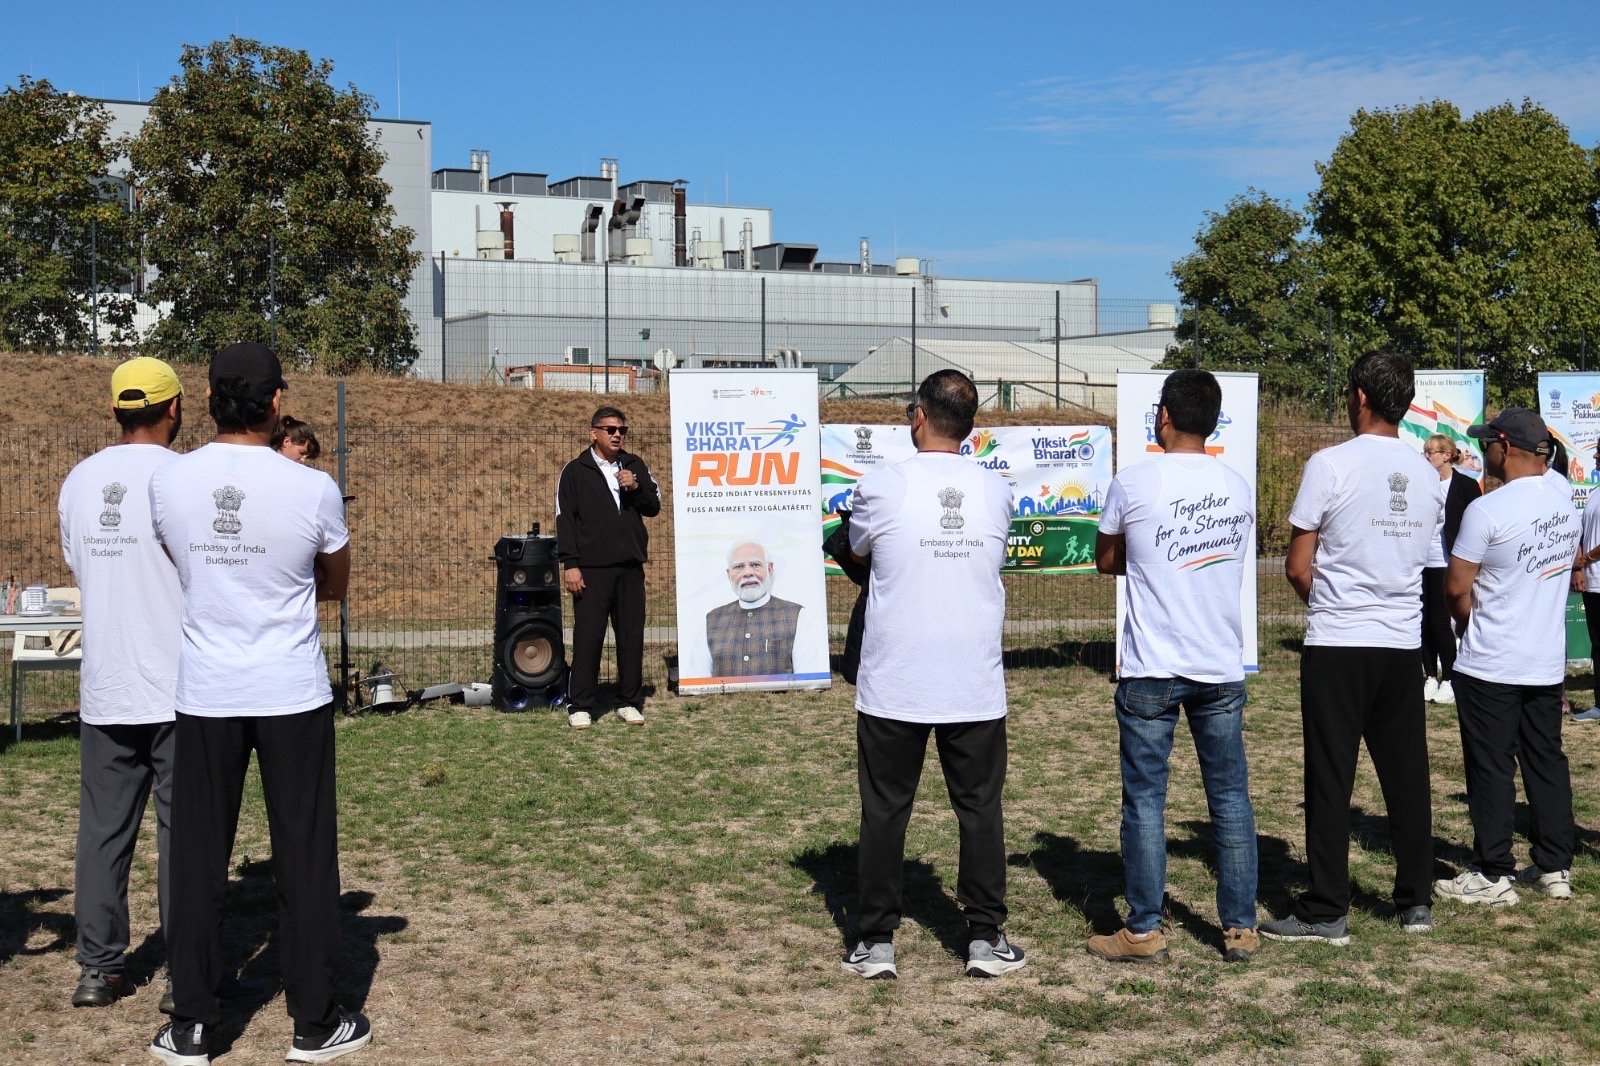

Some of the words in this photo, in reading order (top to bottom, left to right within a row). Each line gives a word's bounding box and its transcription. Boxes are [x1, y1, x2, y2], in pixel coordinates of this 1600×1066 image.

[1572, 400, 1592, 411] Sewa
[1573, 409, 1600, 420] Pakhwa
[685, 421, 745, 437] VIKSIT
[686, 436, 762, 452] BHARAT
[1031, 437, 1068, 449] Viksit
[1033, 447, 1077, 460] Bharat
[687, 452, 800, 487] RUN
[725, 489, 752, 497] INDIÁT
[754, 488, 812, 497] VERSENYFUTÁS
[1169, 492, 1230, 521] Together
[1371, 518, 1399, 528] Embassy
[1399, 519, 1407, 528] of
[1408, 520, 1423, 528] India
[1531, 511, 1570, 537] Together
[1155, 524, 1174, 547] for
[1179, 525, 1190, 536] a
[1194, 514, 1247, 534] Stronger
[1383, 529, 1412, 539] Budapest
[111, 535, 119, 544] of
[120, 535, 138, 544] India
[920, 538, 953, 547] Embassy
[955, 537, 964, 547] of
[965, 538, 984, 547] India
[1008, 535, 1032, 546] NITY
[1167, 528, 1243, 562] Community
[189, 543, 229, 554] Embassy
[231, 543, 242, 553] of
[243, 544, 266, 554] India
[1517, 542, 1534, 562] for
[1537, 542, 1545, 551] a
[1547, 529, 1580, 549] Stronge
[91, 548, 123, 558] Budapest
[933, 550, 970, 559] Budapest
[1017, 546, 1044, 557] DAY
[205, 555, 248, 566] Budapest
